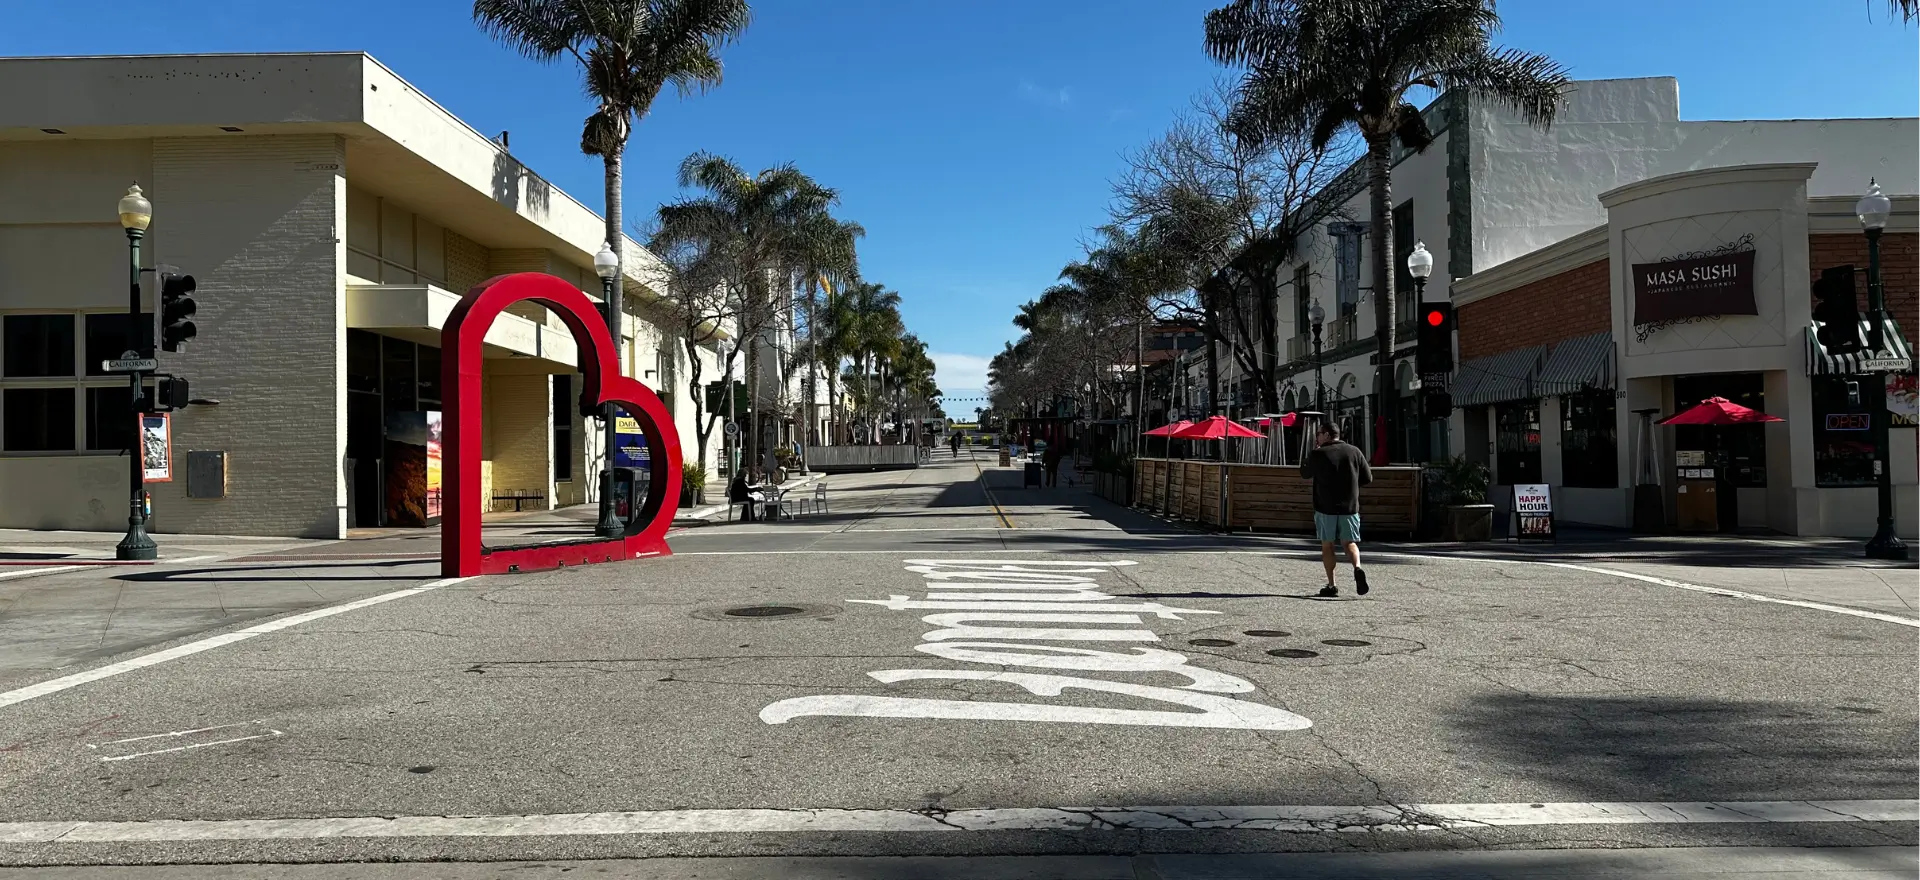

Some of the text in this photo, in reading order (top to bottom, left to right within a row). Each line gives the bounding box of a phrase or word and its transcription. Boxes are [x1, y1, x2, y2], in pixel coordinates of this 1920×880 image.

[1646, 264, 1737, 287] MASA SUSHI
[1865, 360, 1905, 368] CALIFORNIA
[1829, 415, 1868, 428] OPEN
[1518, 495, 1547, 503] HAPPY
[1520, 503, 1549, 511] HOUR
